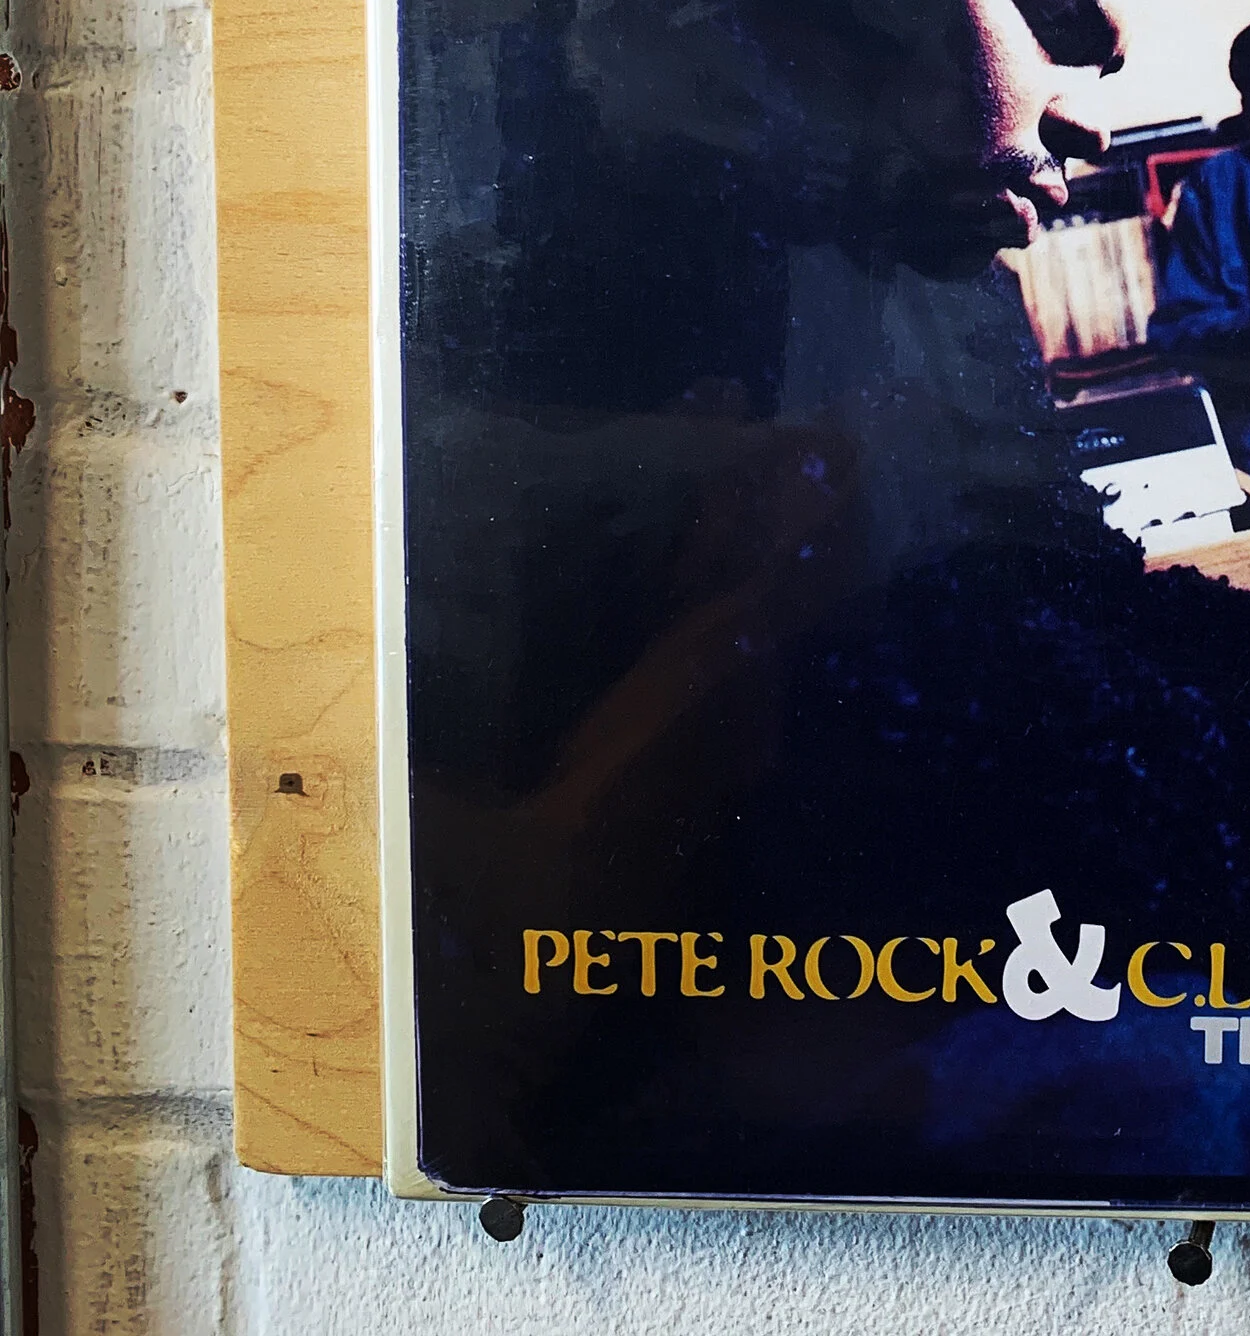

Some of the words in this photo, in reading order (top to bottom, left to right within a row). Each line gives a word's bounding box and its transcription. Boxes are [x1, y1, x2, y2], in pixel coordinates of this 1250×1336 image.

[522, 928, 726, 998] PETE
[749, 934, 998, 1004] ROCK
[1002, 888, 1122, 1022] &
